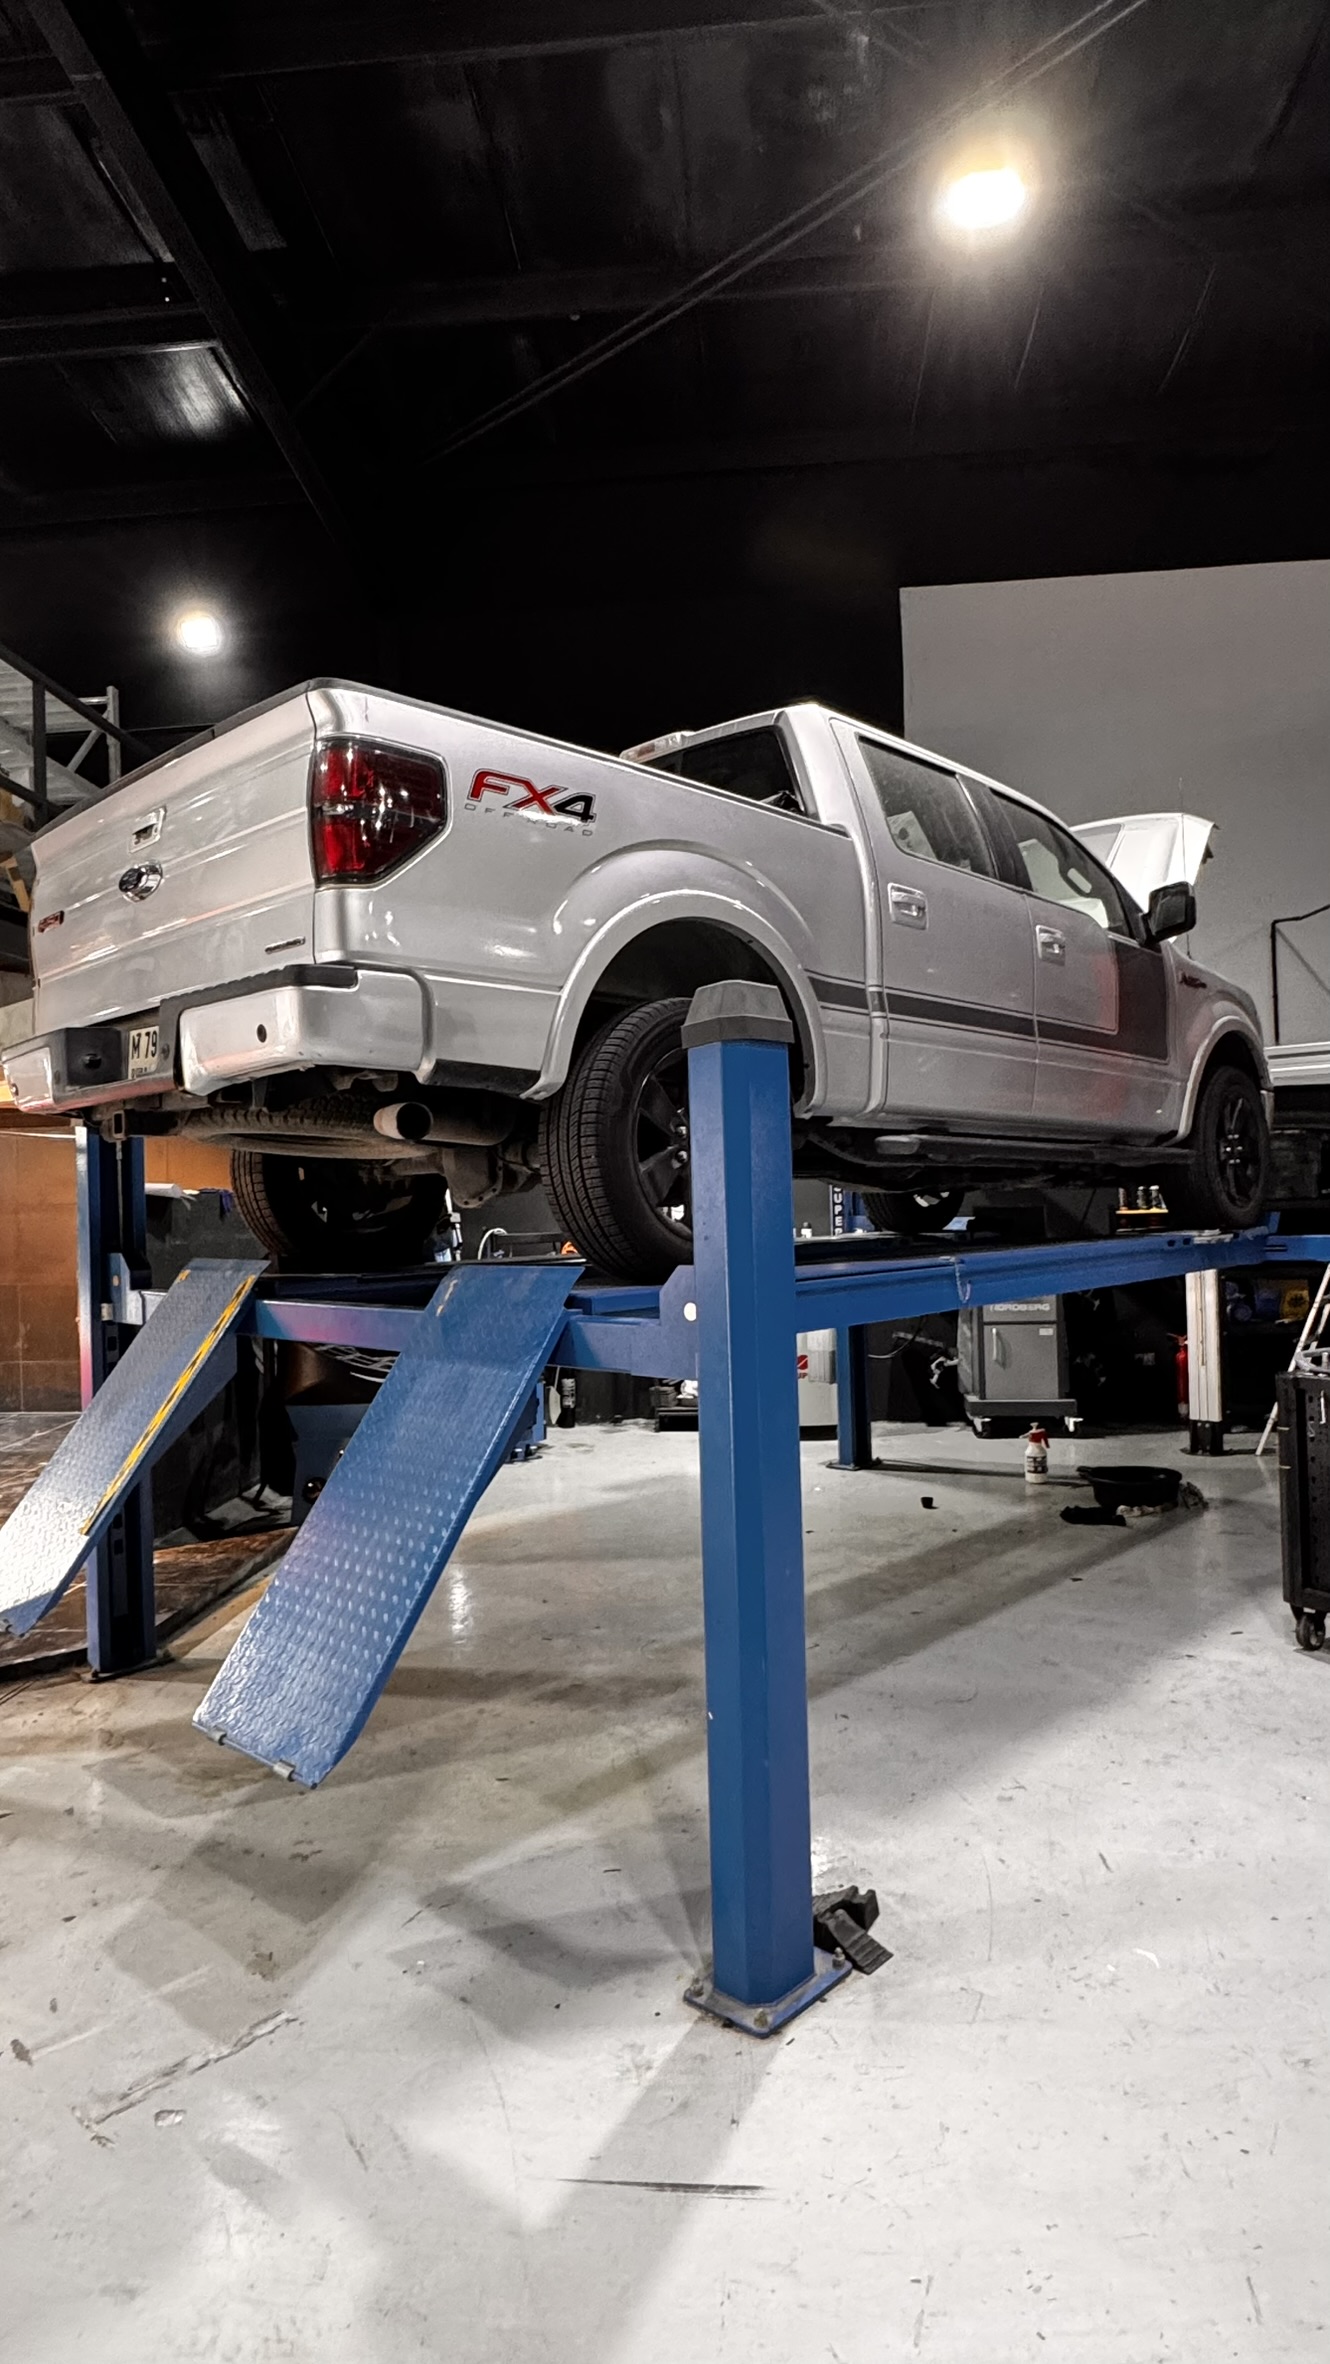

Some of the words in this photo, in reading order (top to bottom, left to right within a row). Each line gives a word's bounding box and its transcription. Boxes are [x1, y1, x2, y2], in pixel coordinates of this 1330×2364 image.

[464, 803, 515, 818] OFF
[467, 768, 597, 826] FX4
[144, 1030, 158, 1059] 79
